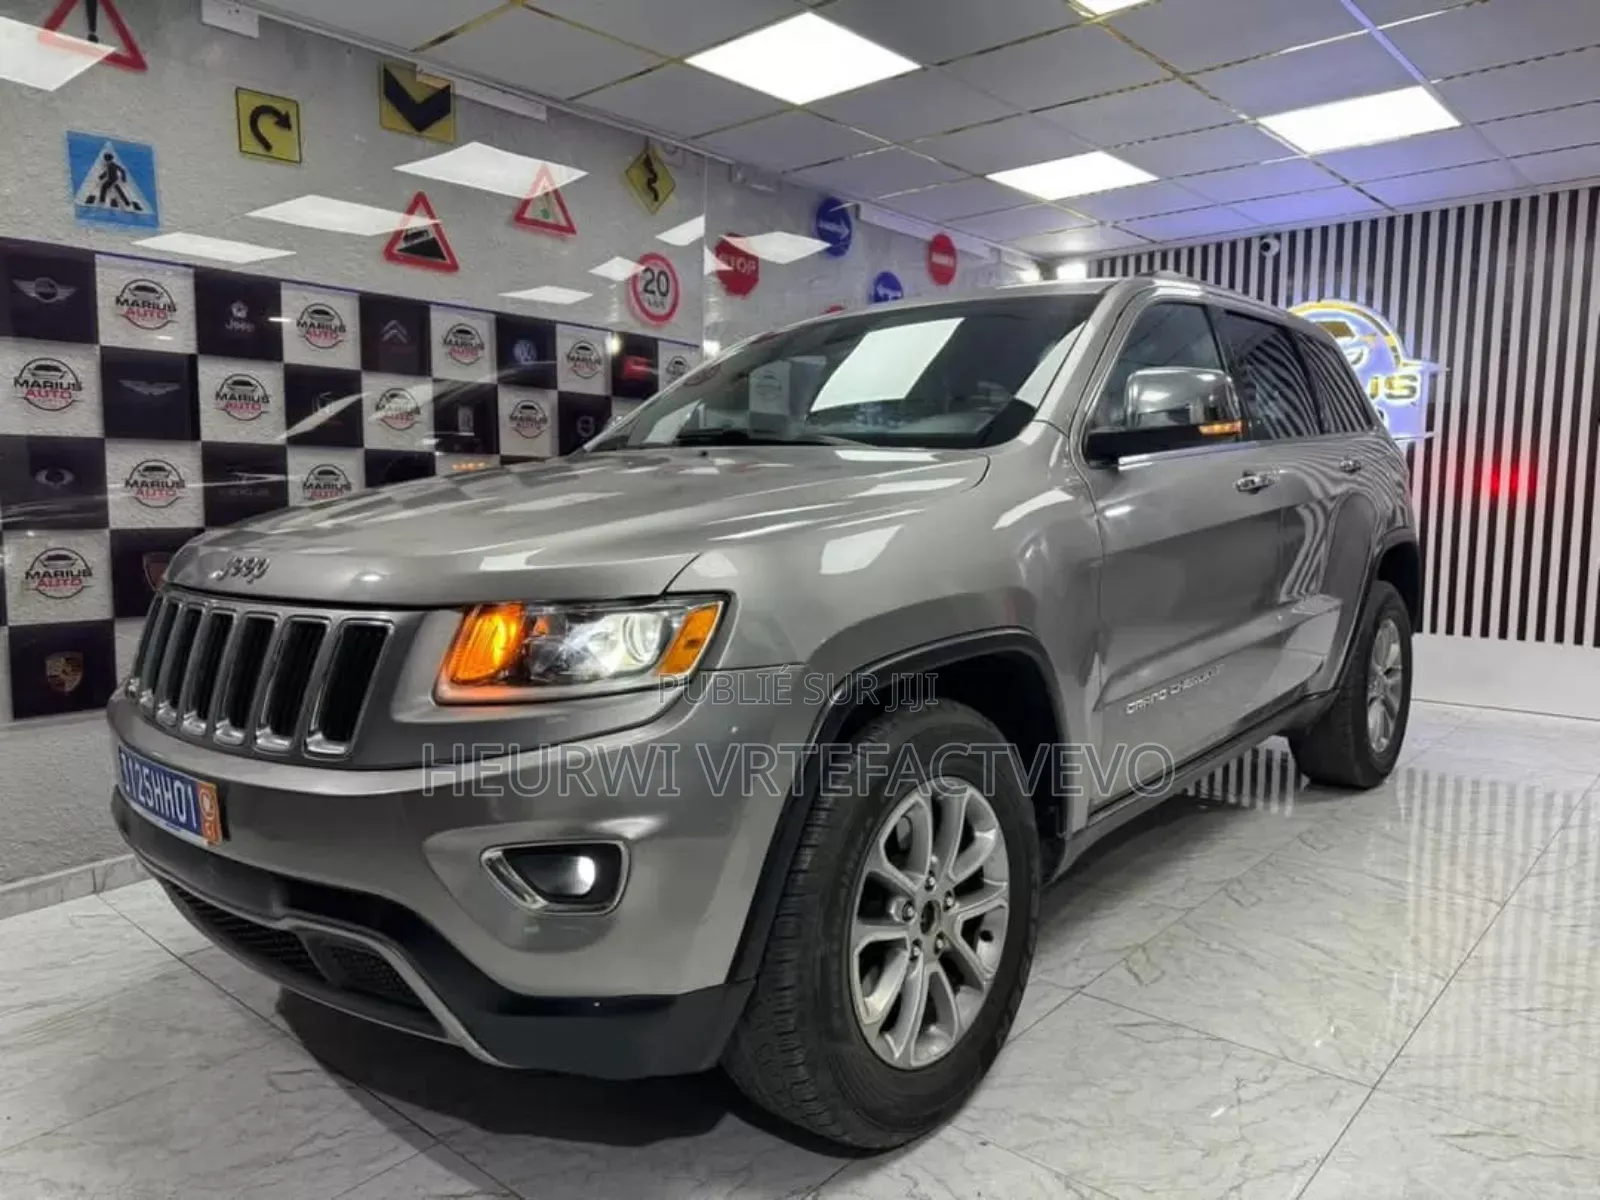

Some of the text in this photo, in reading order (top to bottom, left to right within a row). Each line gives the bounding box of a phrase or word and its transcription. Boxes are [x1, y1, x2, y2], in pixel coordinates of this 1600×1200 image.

[642, 267, 670, 297] 20
[116, 295, 176, 312] MARIUS
[126, 307, 168, 320] AUTO
[14, 376, 82, 392] MARIUS
[25, 389, 73, 400] AUTO
[215, 391, 271, 404] MARIUS
[125, 479, 186, 489] MARIUS
[135, 487, 178, 498] AUTO
[25, 569, 92, 580] MARIUS
[38, 577, 83, 588] AUTO
